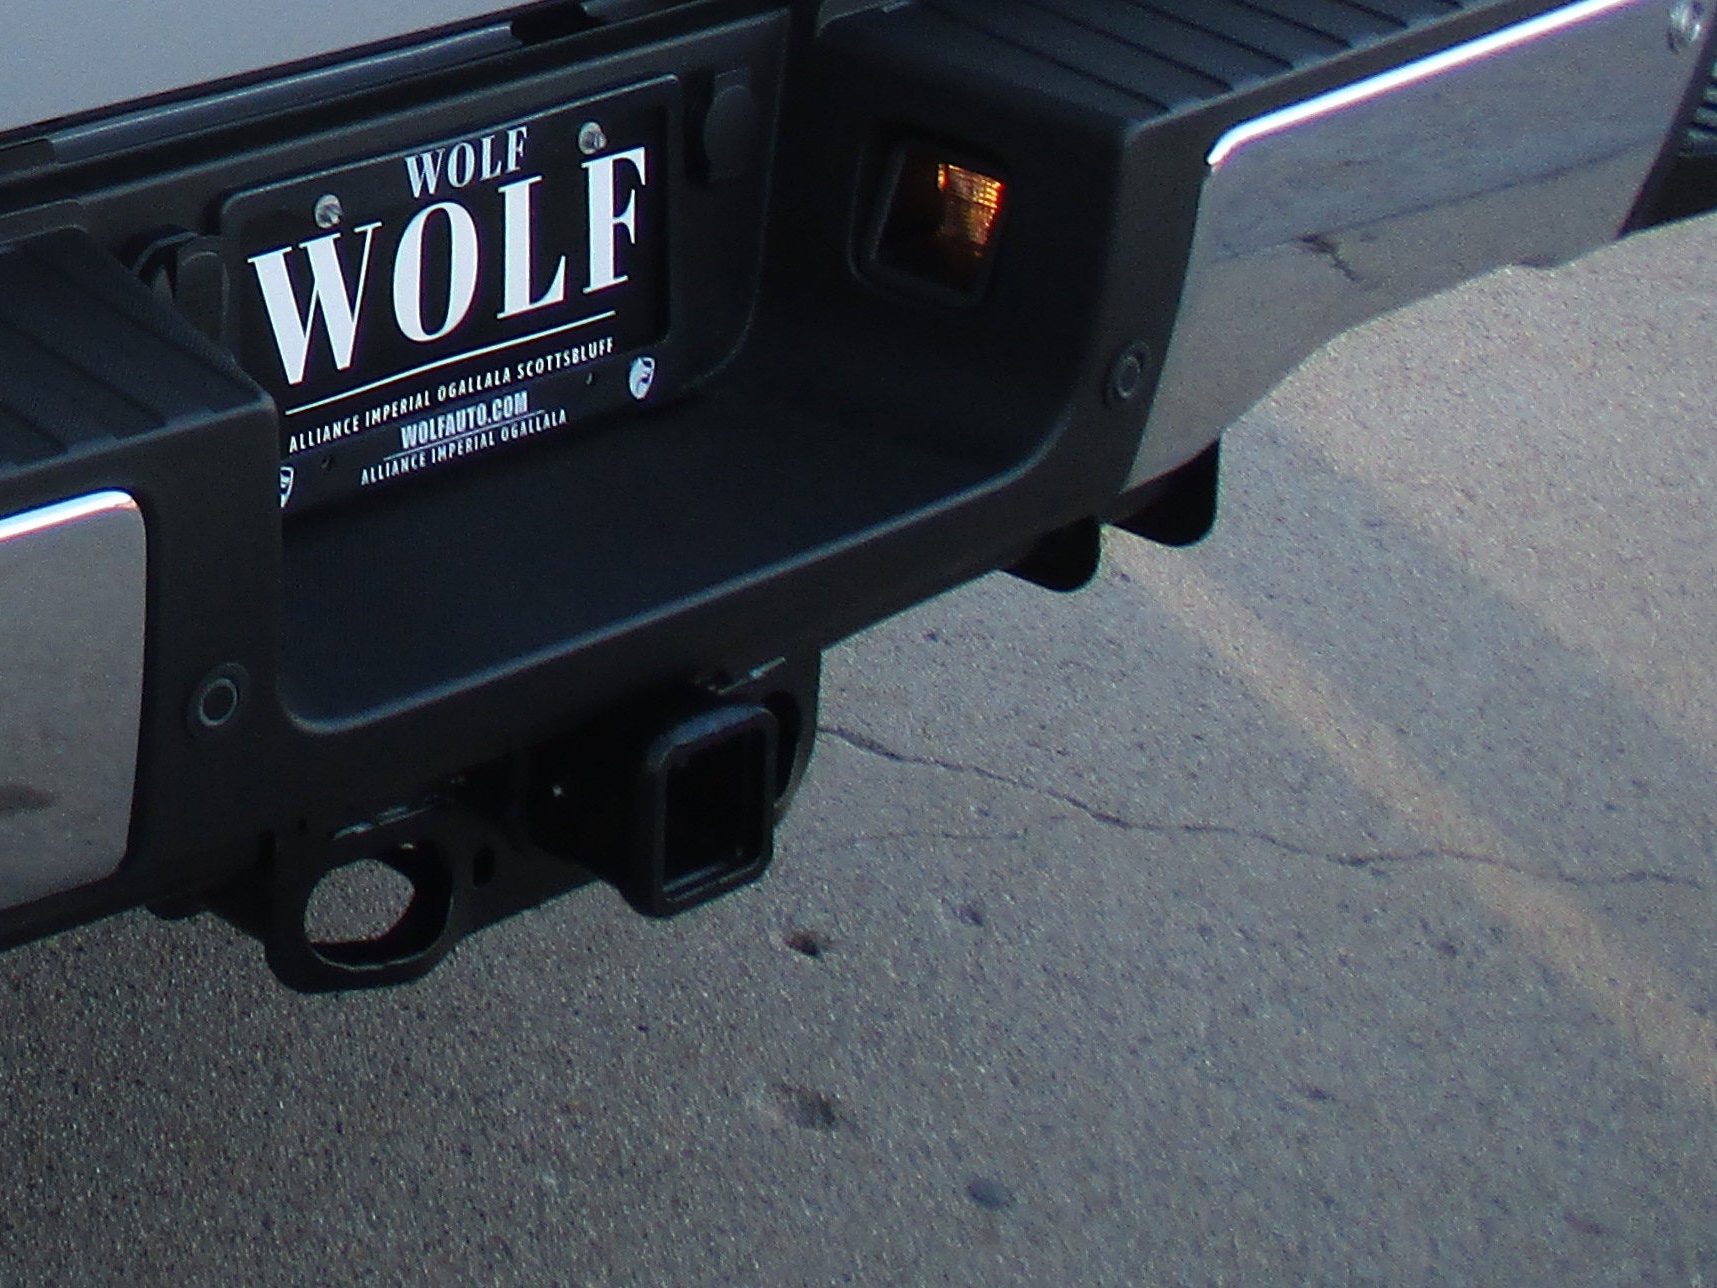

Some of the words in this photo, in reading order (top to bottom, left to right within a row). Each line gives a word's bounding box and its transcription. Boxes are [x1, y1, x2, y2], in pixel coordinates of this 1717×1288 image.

[404, 126, 528, 198] WOLF
[247, 146, 647, 386] WOLF
[289, 414, 359, 453] ALLIANCE
[365, 392, 431, 428] IMPERIAL
[437, 367, 511, 402] OGALLALA
[517, 336, 614, 380] SCOTTSBLUFF
[400, 390, 528, 449] WOLFAUTO.COM
[361, 454, 426, 486] ALLIANCE
[431, 431, 495, 464] IMPERIAL
[501, 409, 567, 442] OGALLALA
